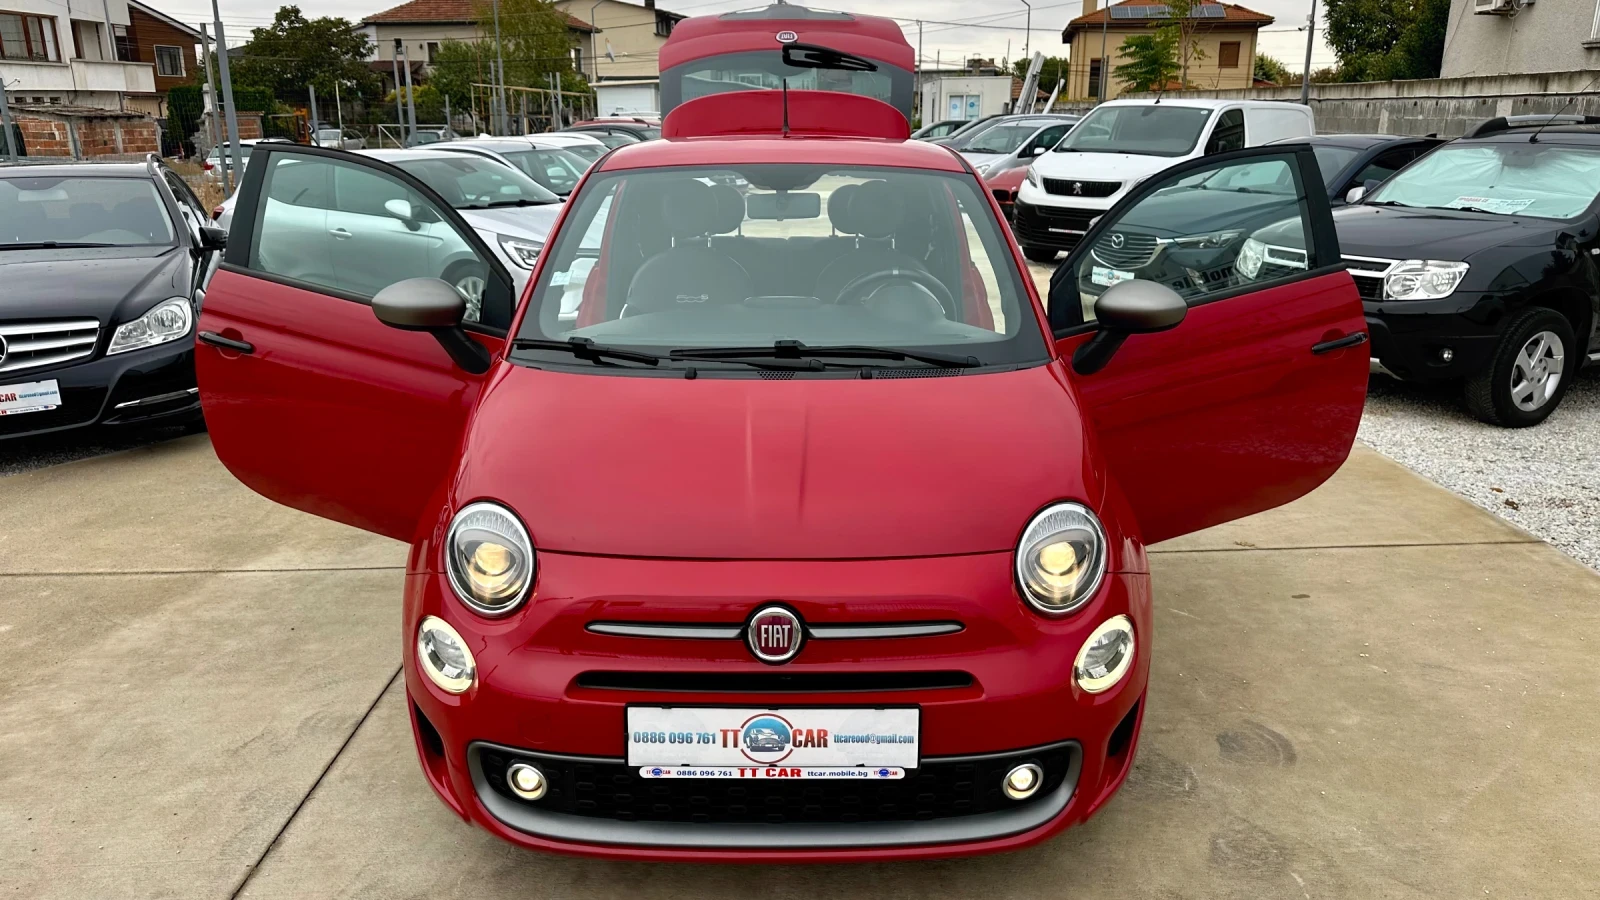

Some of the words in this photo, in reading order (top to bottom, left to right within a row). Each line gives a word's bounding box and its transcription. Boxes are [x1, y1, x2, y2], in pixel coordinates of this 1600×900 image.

[761, 624, 791, 648] FIAT
[634, 731, 665, 743] 0886
[669, 732, 693, 744] 096
[696, 732, 716, 744] 761
[720, 729, 741, 748] TT
[792, 729, 828, 748] CAR
[738, 767, 759, 778] TT
[765, 767, 802, 778] CAR
